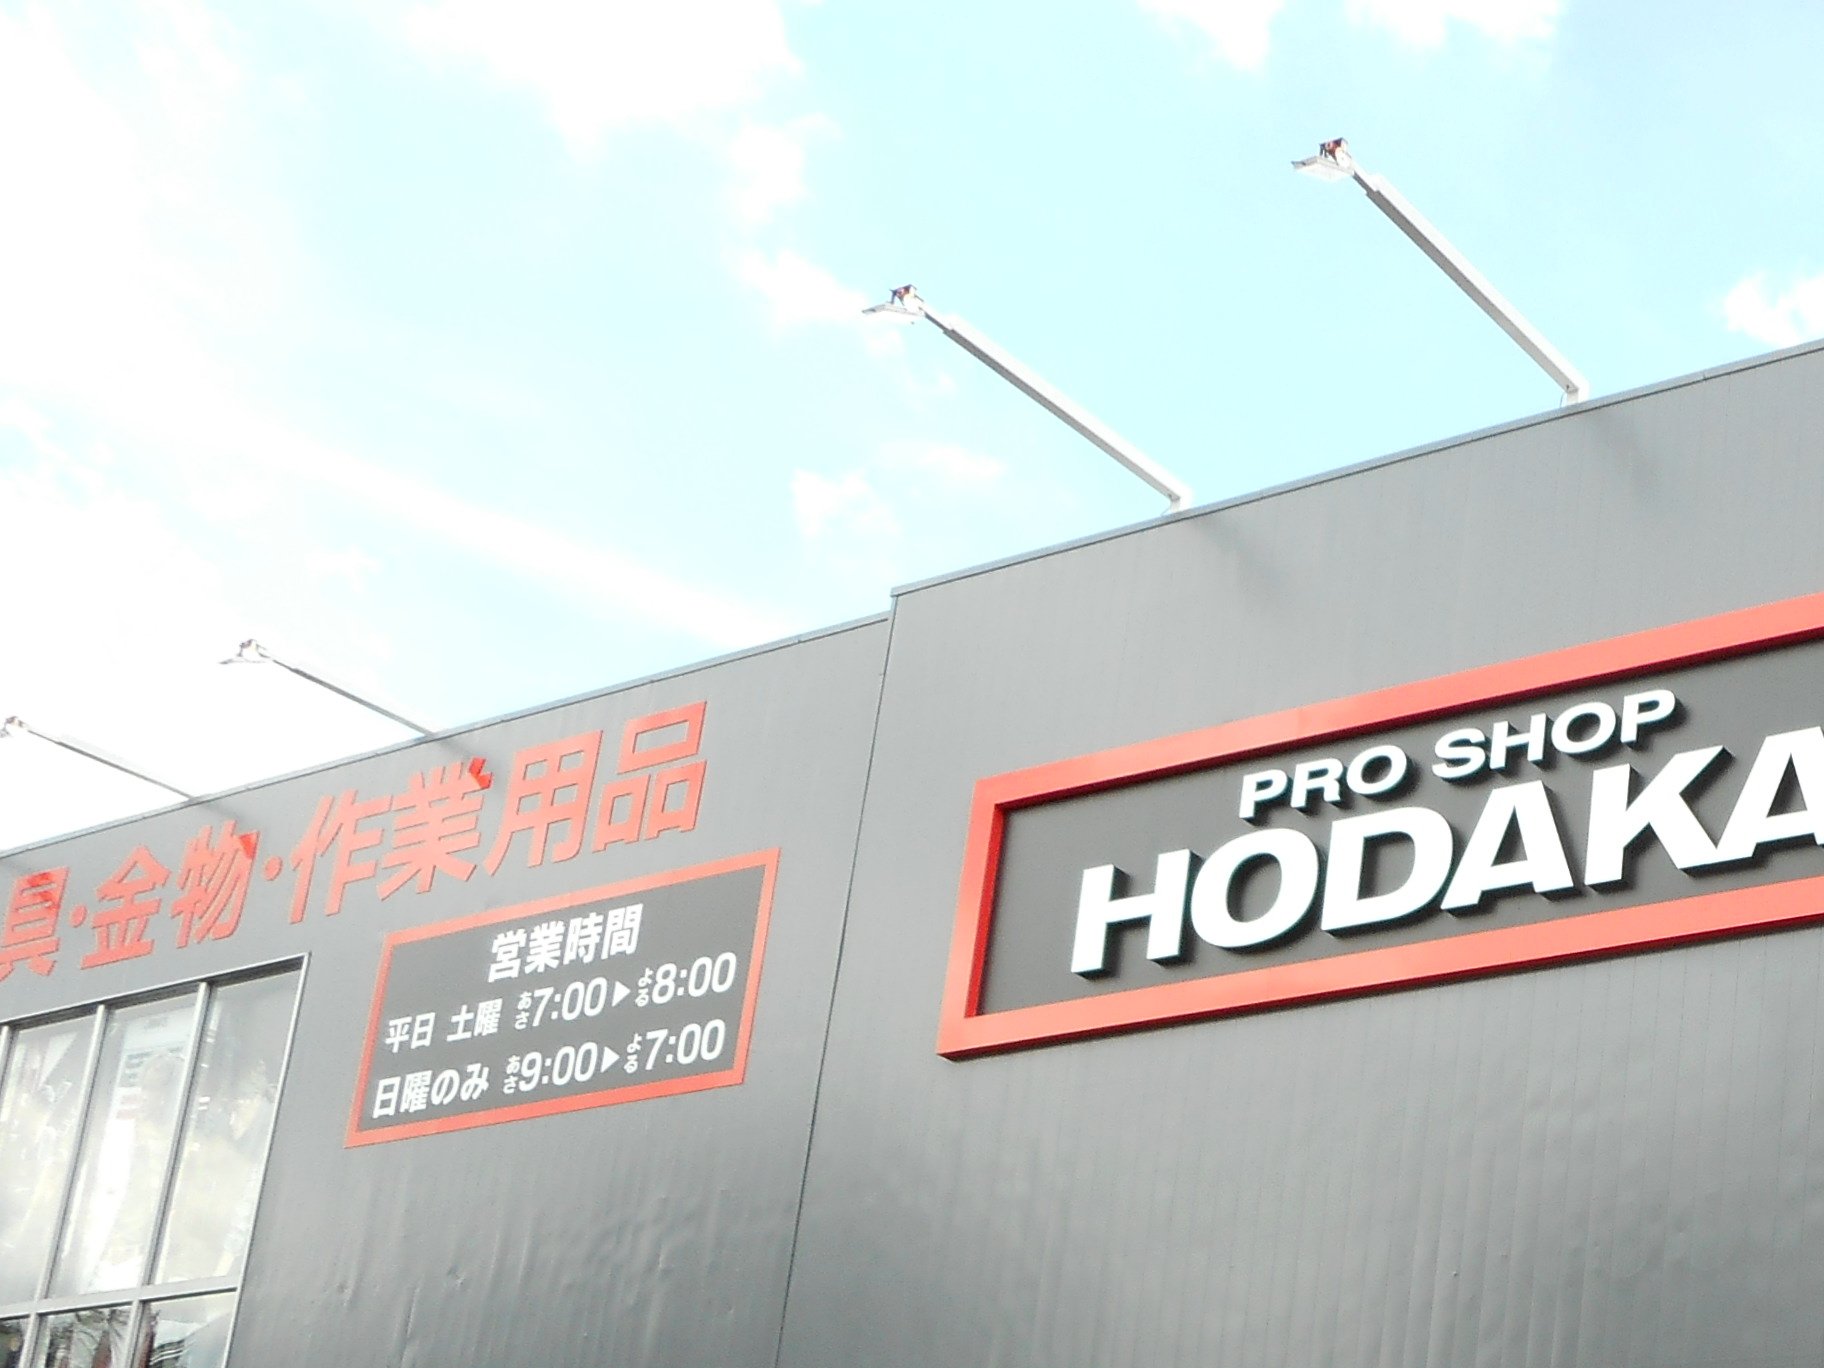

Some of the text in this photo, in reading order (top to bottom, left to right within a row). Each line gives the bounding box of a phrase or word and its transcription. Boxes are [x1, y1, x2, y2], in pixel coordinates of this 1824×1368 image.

[1238, 689, 1676, 820] PRO SHOP
[486, 903, 644, 983] 営業時間
[385, 1004, 434, 1054] 平日
[446, 998, 502, 1044] 土曜
[371, 1062, 490, 1119] 日曜のみ
